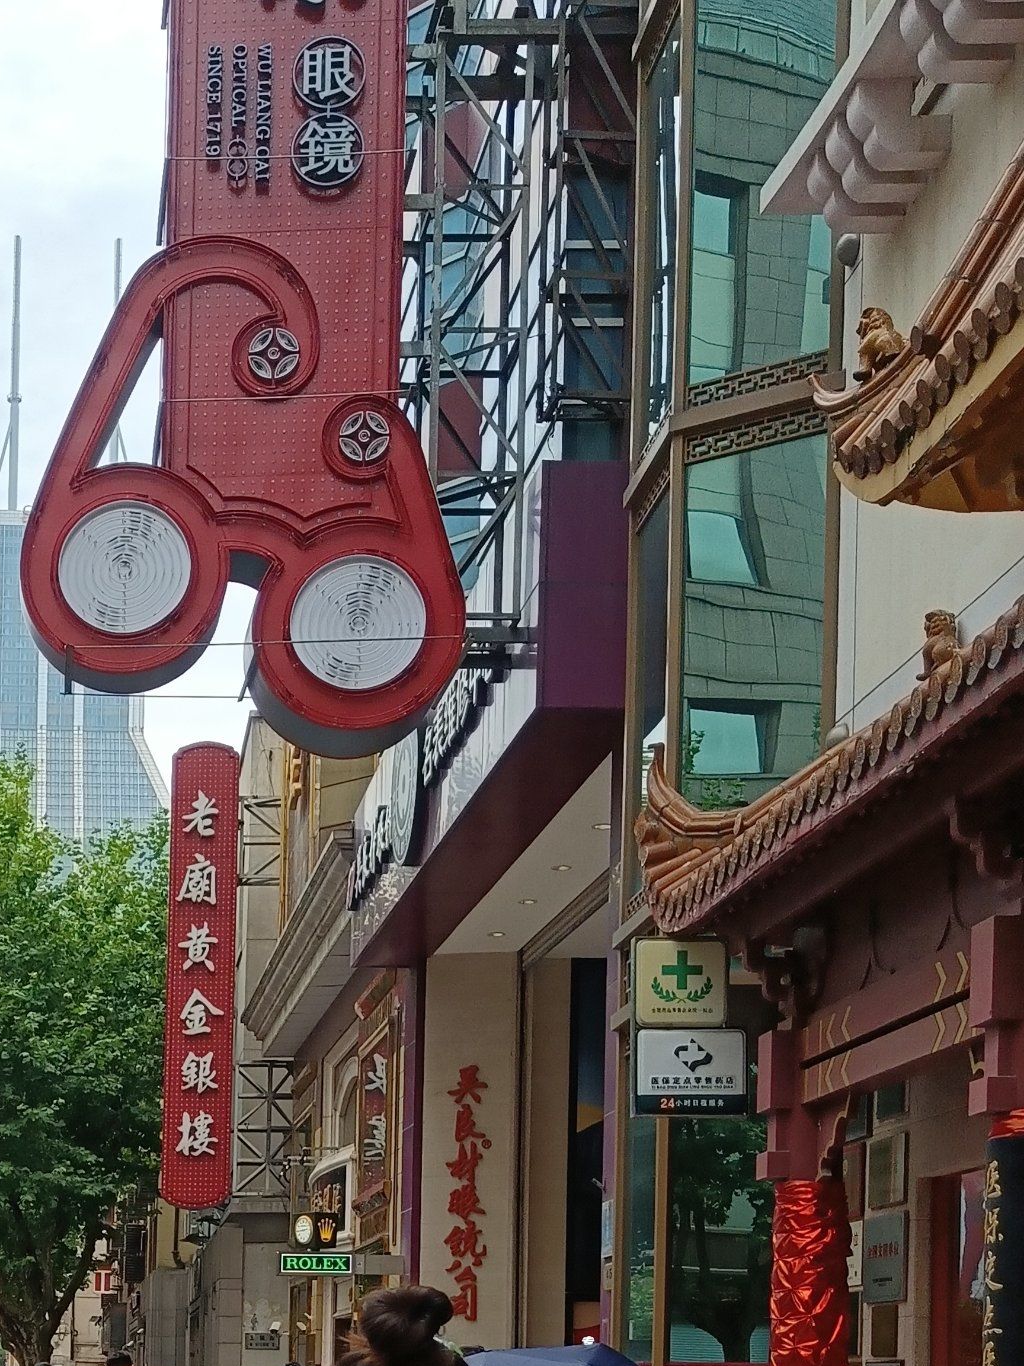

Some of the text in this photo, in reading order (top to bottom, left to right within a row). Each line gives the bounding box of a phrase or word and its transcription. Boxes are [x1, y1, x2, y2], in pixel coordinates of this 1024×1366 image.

[206, 45, 223, 156] SINCE 1719
[232, 43, 248, 126] OPTICAL
[255, 42, 272, 180] WU LIANG CAI
[285, 1257, 347, 1270] ROLEX
